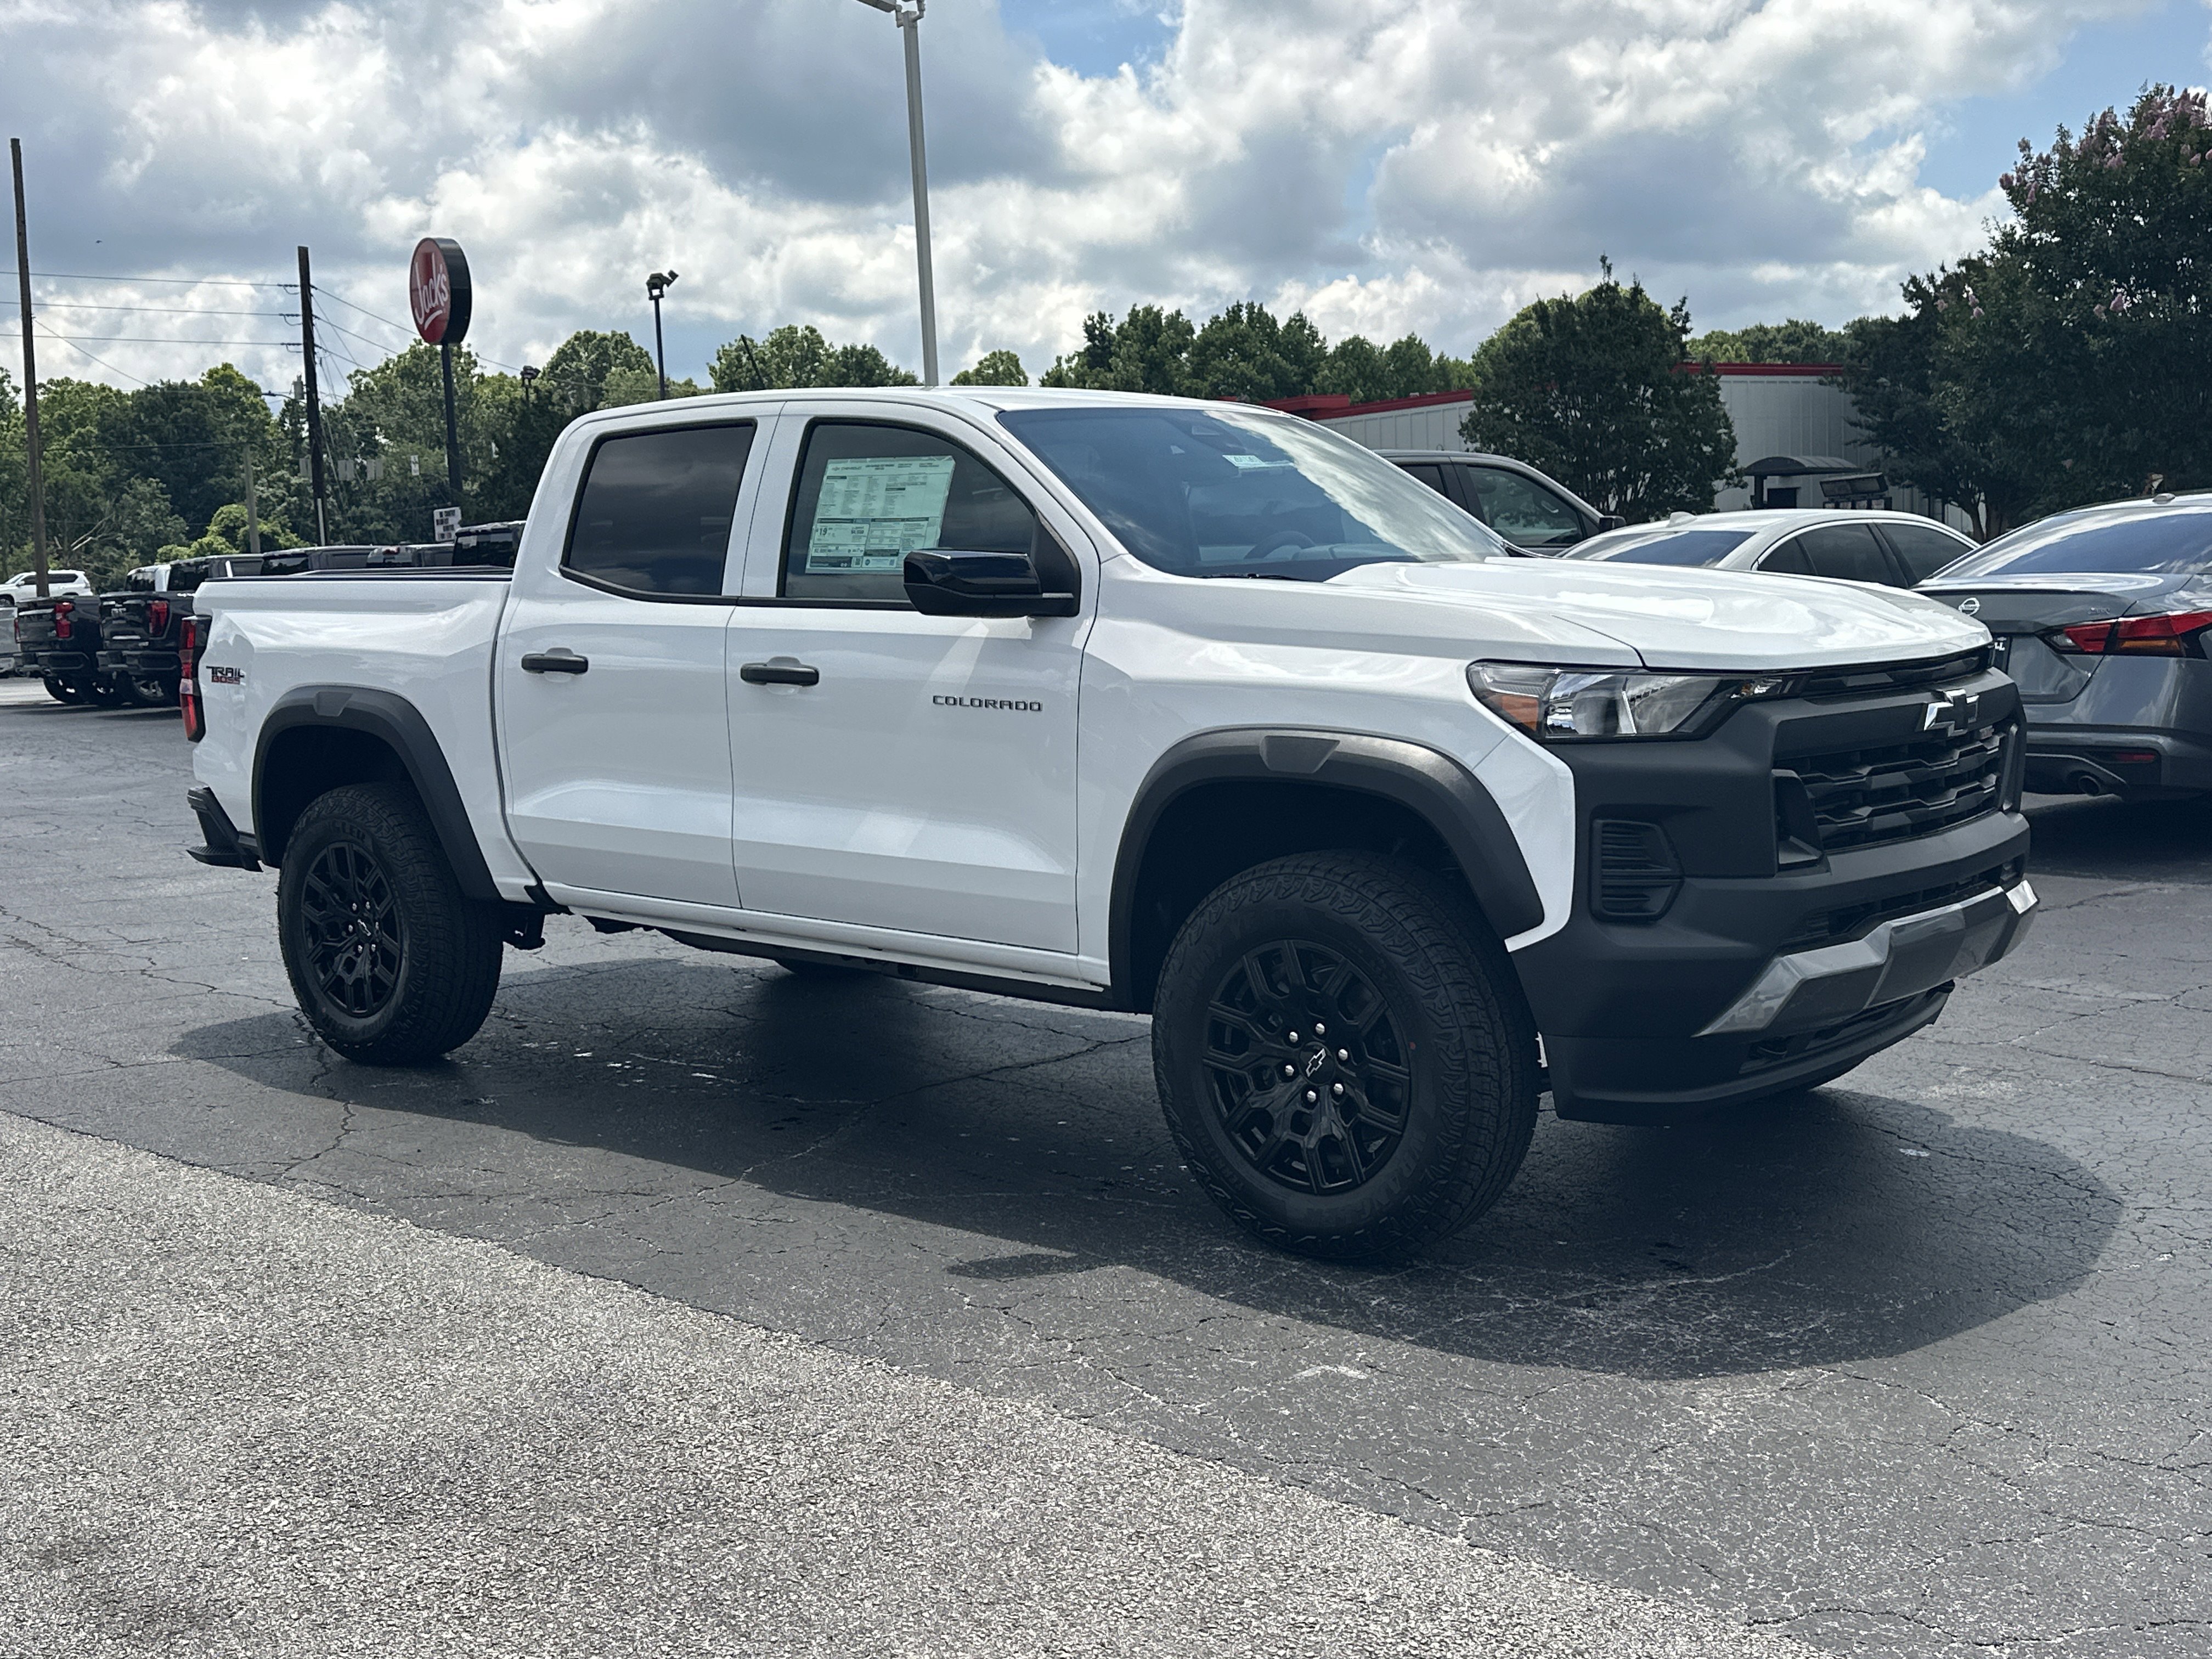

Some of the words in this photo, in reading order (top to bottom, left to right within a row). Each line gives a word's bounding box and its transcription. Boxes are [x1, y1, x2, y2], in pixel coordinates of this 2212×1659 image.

[415, 253, 448, 325] Jack's
[206, 665, 245, 678] TRAIL
[212, 675, 240, 685] BOSS
[932, 695, 1043, 712] COLORADO
